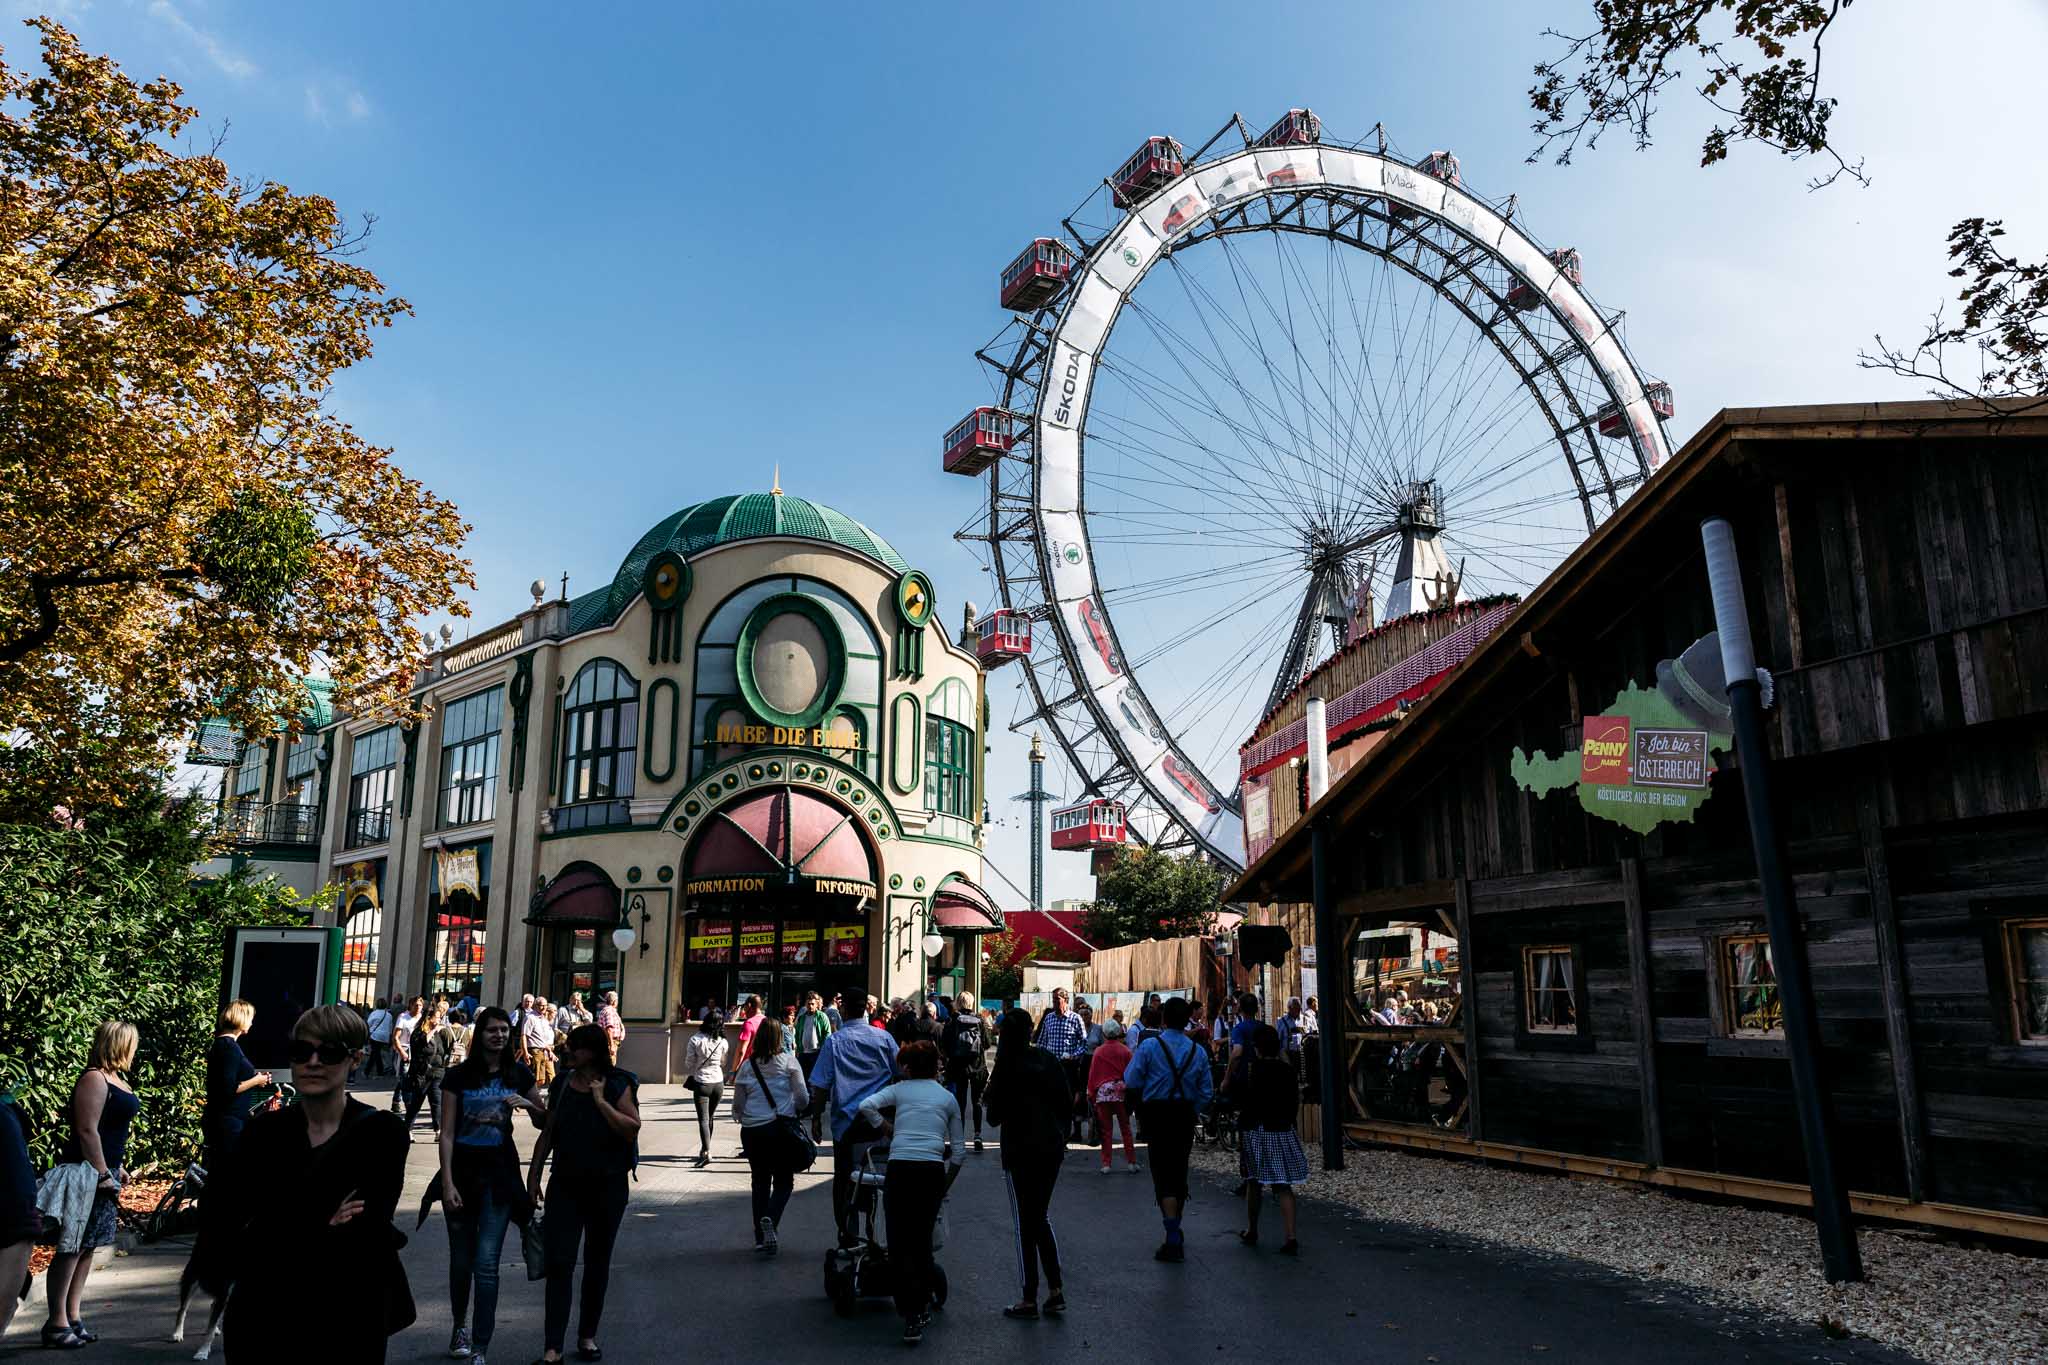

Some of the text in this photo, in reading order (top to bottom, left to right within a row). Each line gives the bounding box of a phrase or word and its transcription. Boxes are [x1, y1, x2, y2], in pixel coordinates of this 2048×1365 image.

[1054, 352, 1082, 424] ŠKODA
[717, 724, 768, 744] HABE
[773, 726, 807, 746] DIE
[1648, 735, 1692, 754] Ich bin
[1583, 739, 1628, 757] PENNY
[1600, 759, 1621, 767] MARKT
[1639, 754, 1701, 780] ÖSTERREICH
[1597, 787, 1687, 807] KÖSTLICHES AUS DER REGION
[687, 878, 766, 896] INFORMATION
[815, 879, 877, 900] INFORMATION
[703, 938, 732, 946] PARTY-
[741, 934, 775, 944] TICKETS
[782, 945, 797, 953] 2016
